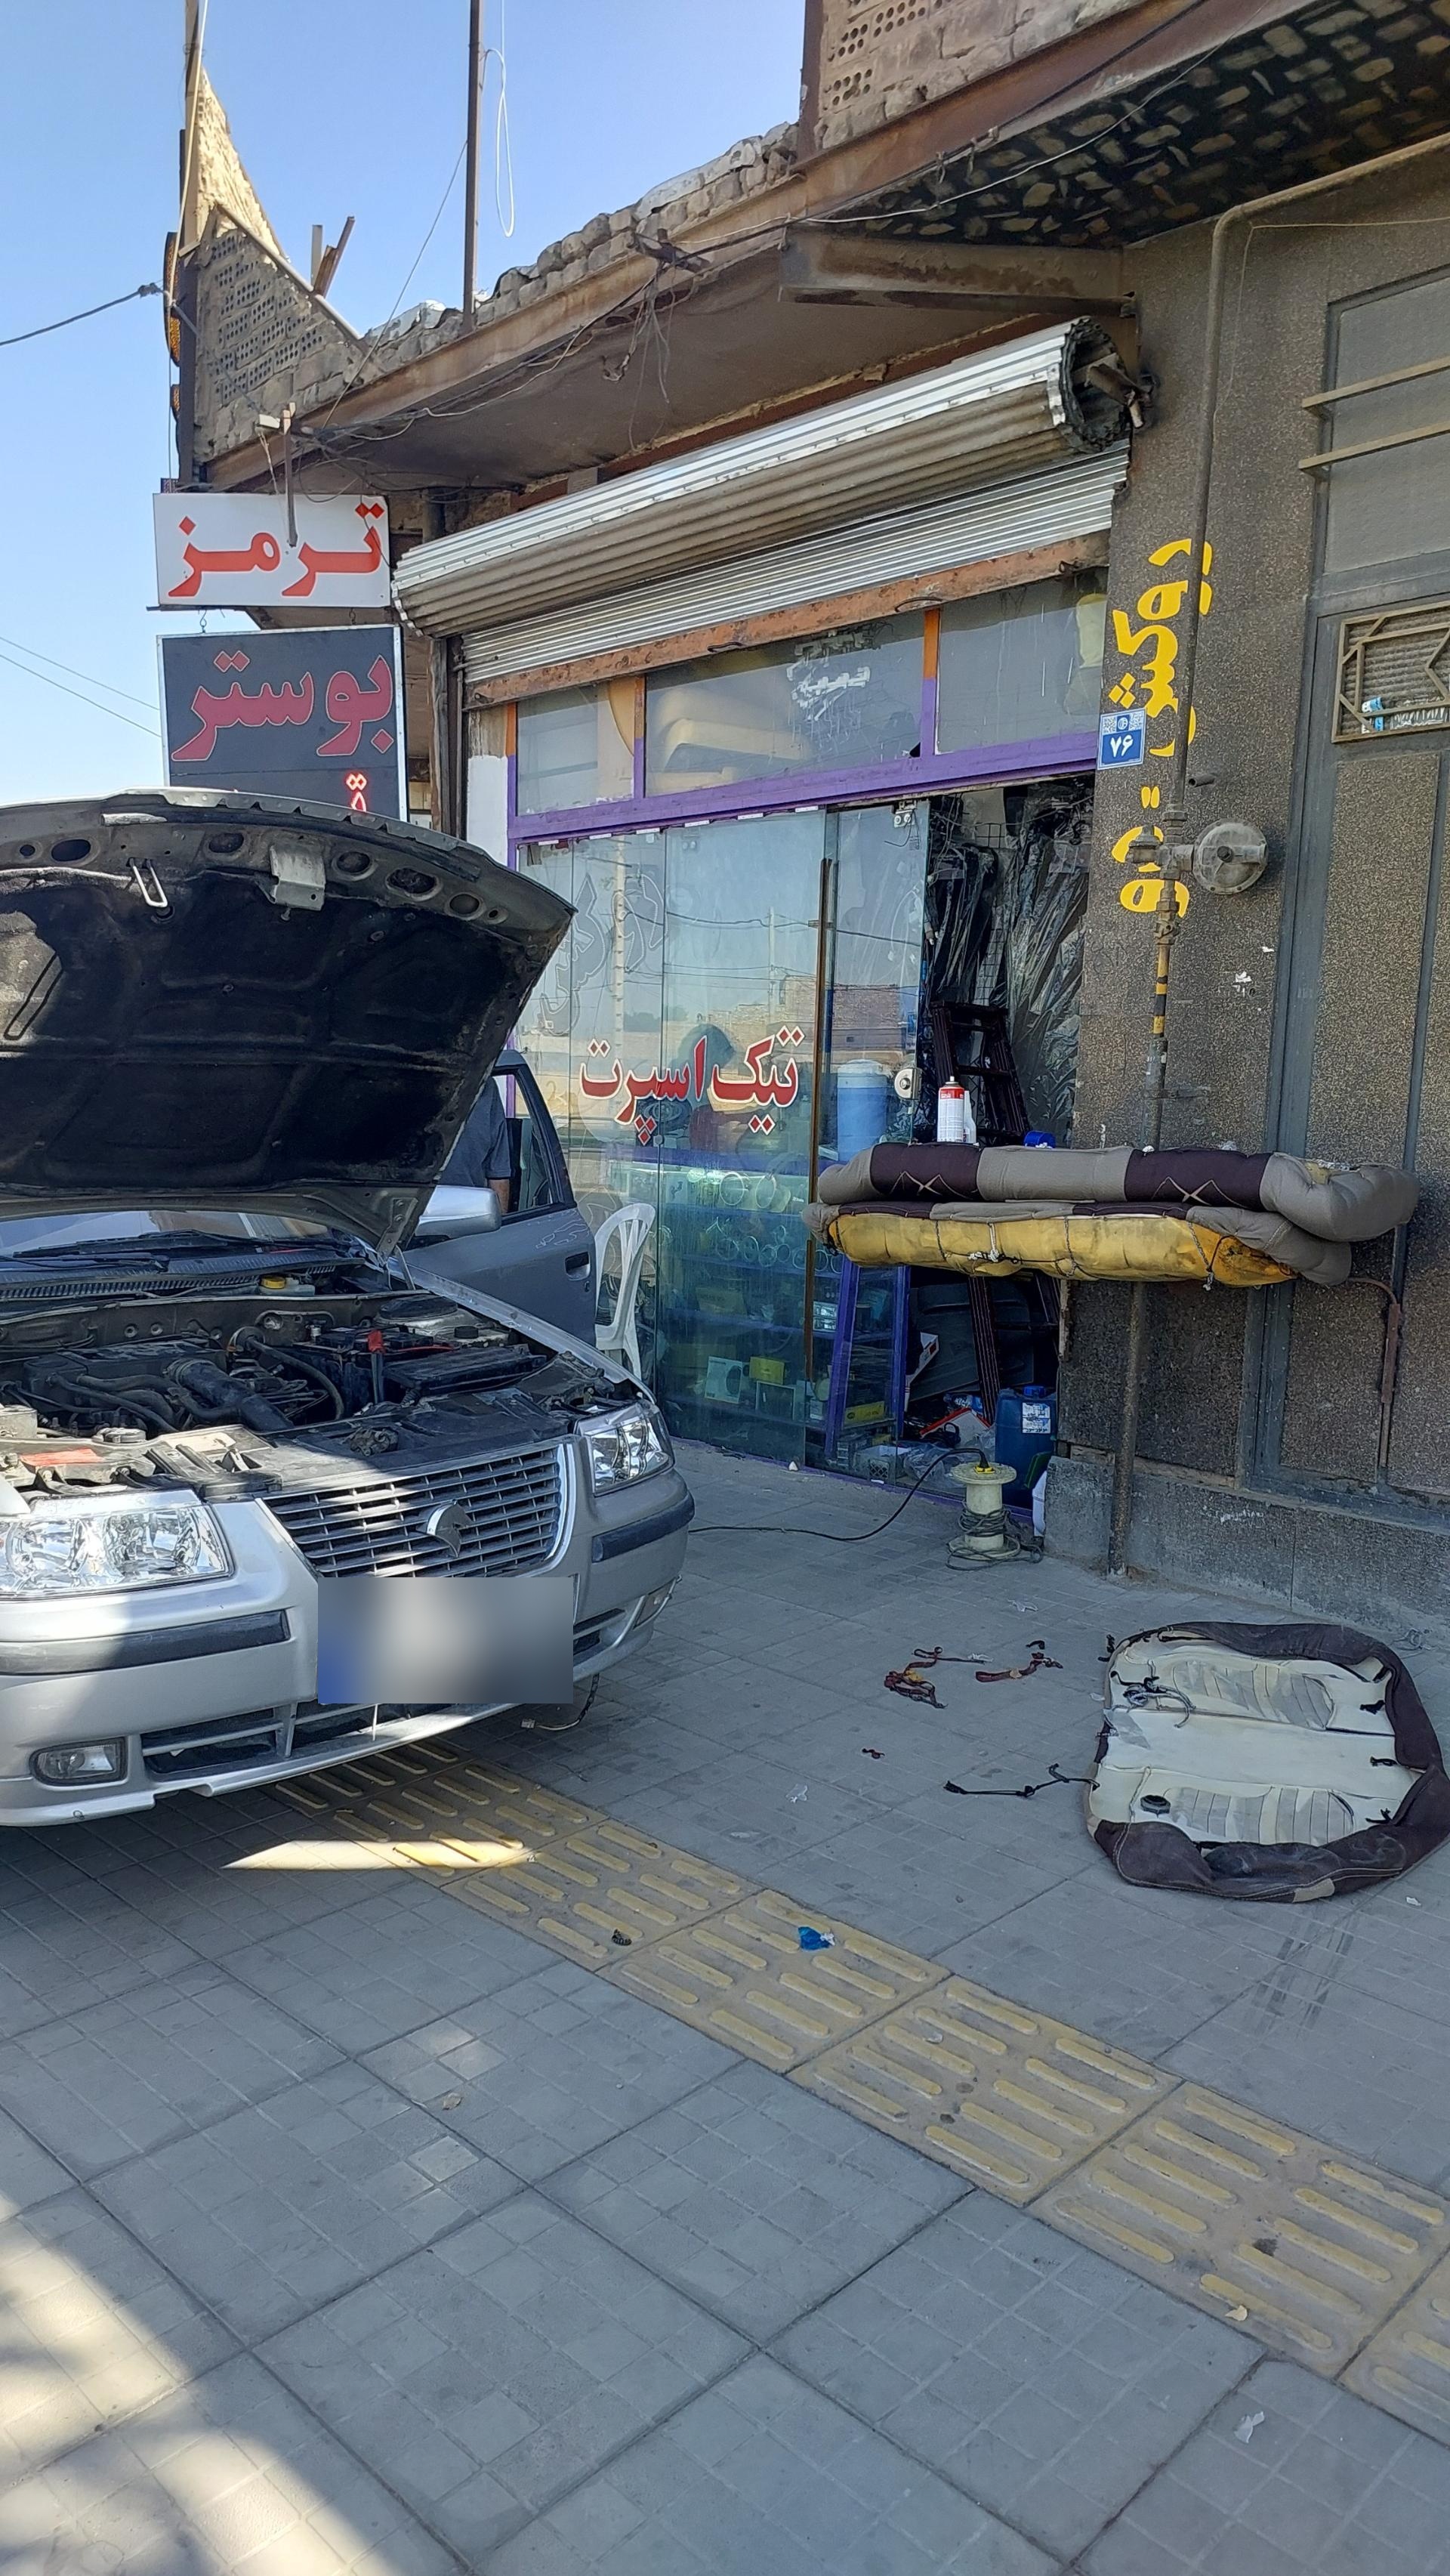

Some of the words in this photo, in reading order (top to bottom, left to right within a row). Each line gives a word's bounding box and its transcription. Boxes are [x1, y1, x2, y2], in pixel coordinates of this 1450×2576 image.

[168, 502, 384, 597] ترمز
[171, 651, 393, 761] بوستر
[1110, 734, 1134, 758] ۷۶
[579, 1034, 706, 1145] اسپرت
[711, 1025, 804, 1135] تیک
